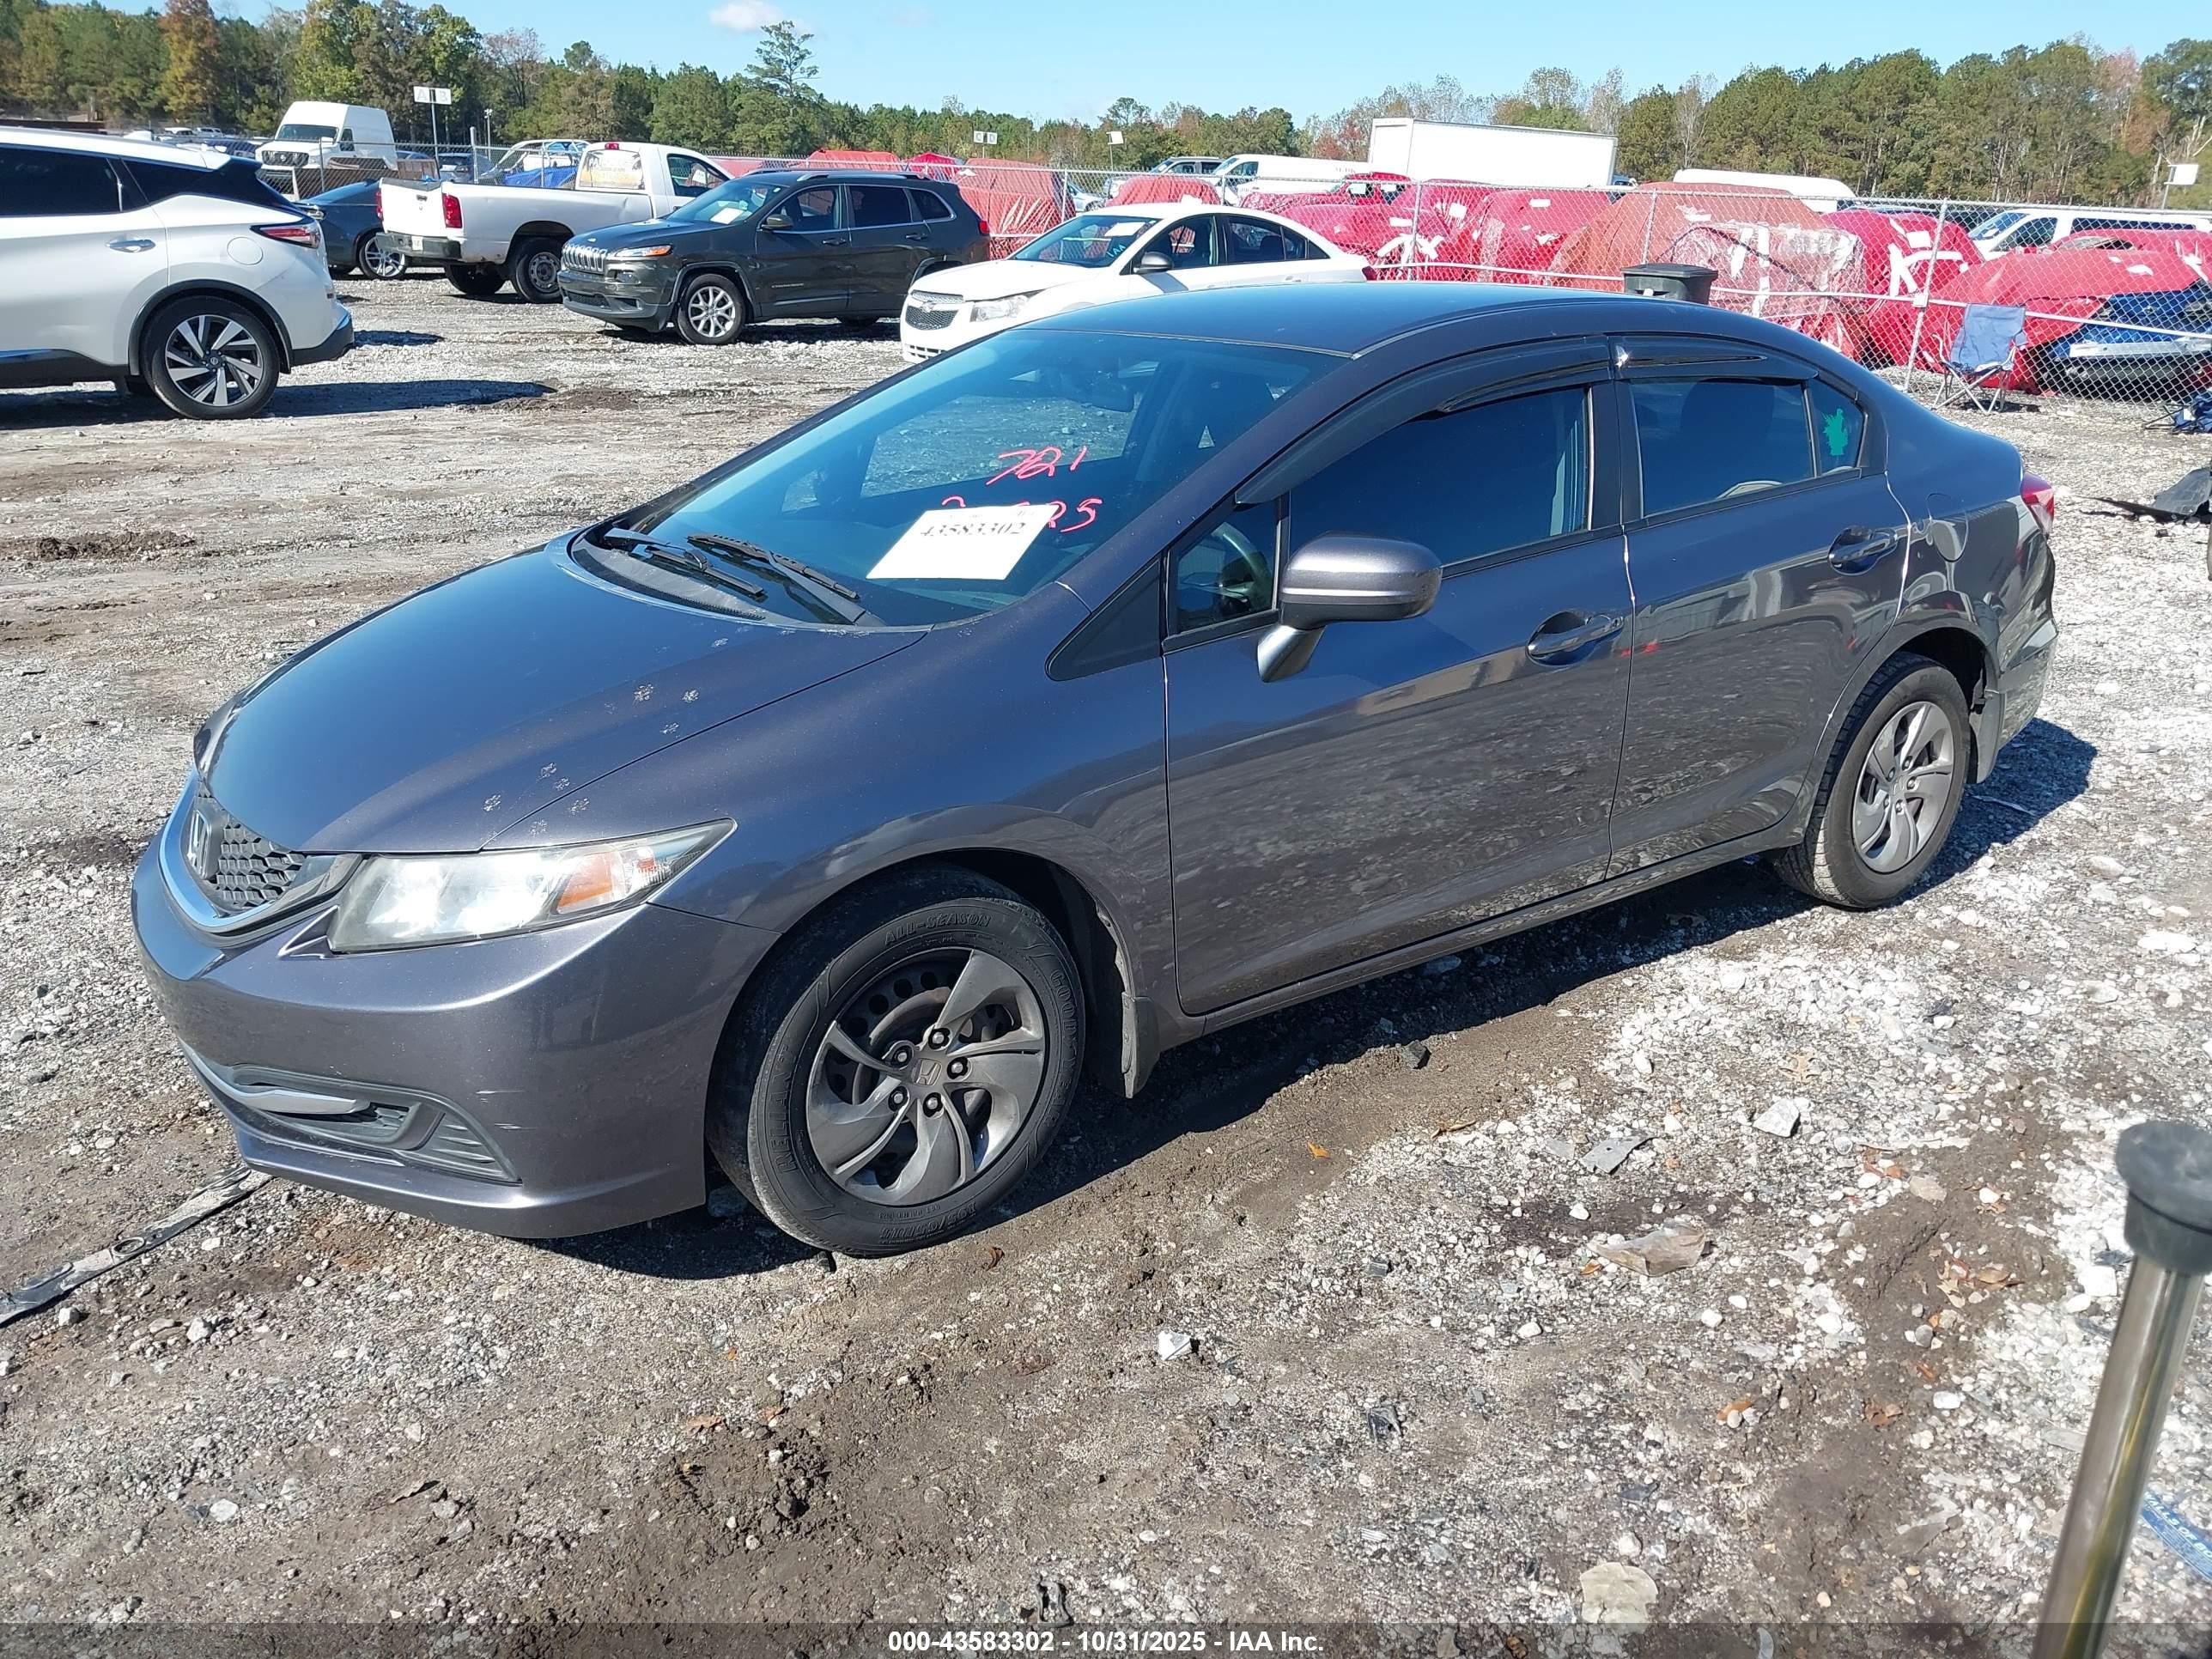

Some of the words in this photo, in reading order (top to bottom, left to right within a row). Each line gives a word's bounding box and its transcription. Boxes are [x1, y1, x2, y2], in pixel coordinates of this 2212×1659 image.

[416, 88, 428, 101] A
[439, 89, 447, 102] B
[884, 913, 992, 945] ALL-SEASON
